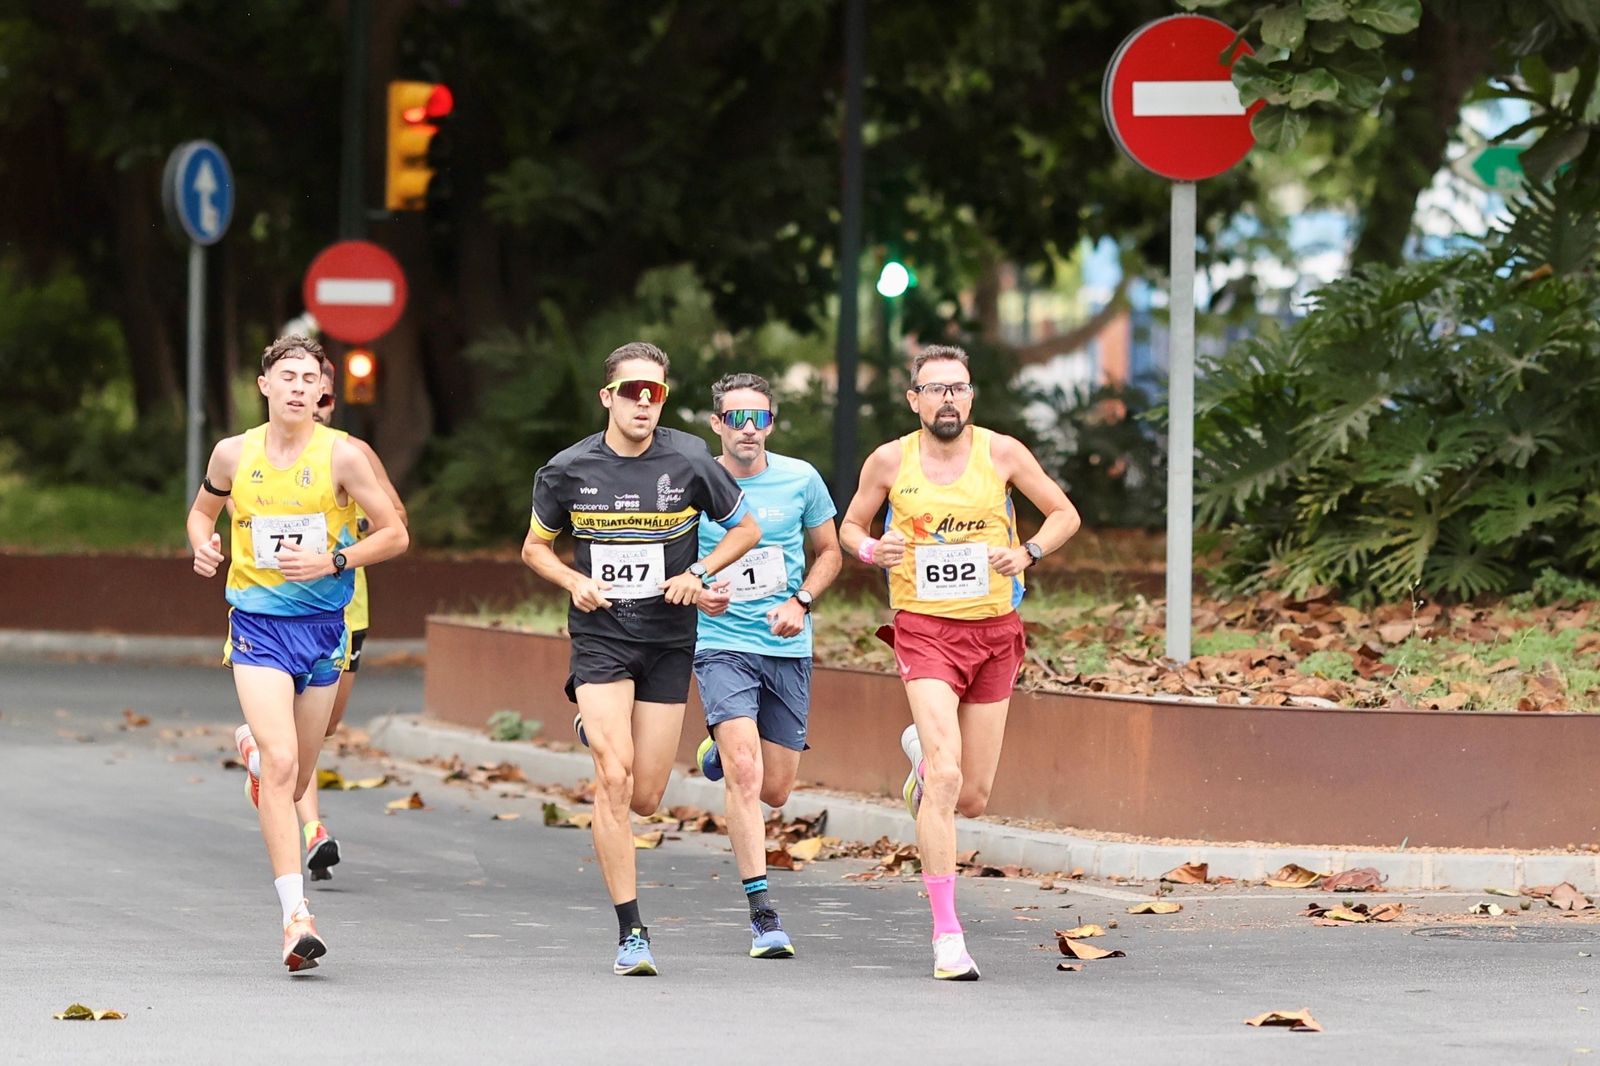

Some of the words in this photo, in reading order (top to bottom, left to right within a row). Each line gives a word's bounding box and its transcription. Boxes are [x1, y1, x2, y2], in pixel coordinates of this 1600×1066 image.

[580, 487, 598, 495] vive
[614, 500, 640, 510] gress
[577, 517, 595, 527] CLUB
[596, 516, 642, 527] TRIATLÓN
[935, 513, 987, 534] Álora
[270, 533, 303, 553] 77
[601, 564, 650, 582] 847
[742, 567, 755, 584] 1
[926, 562, 976, 582] 692
